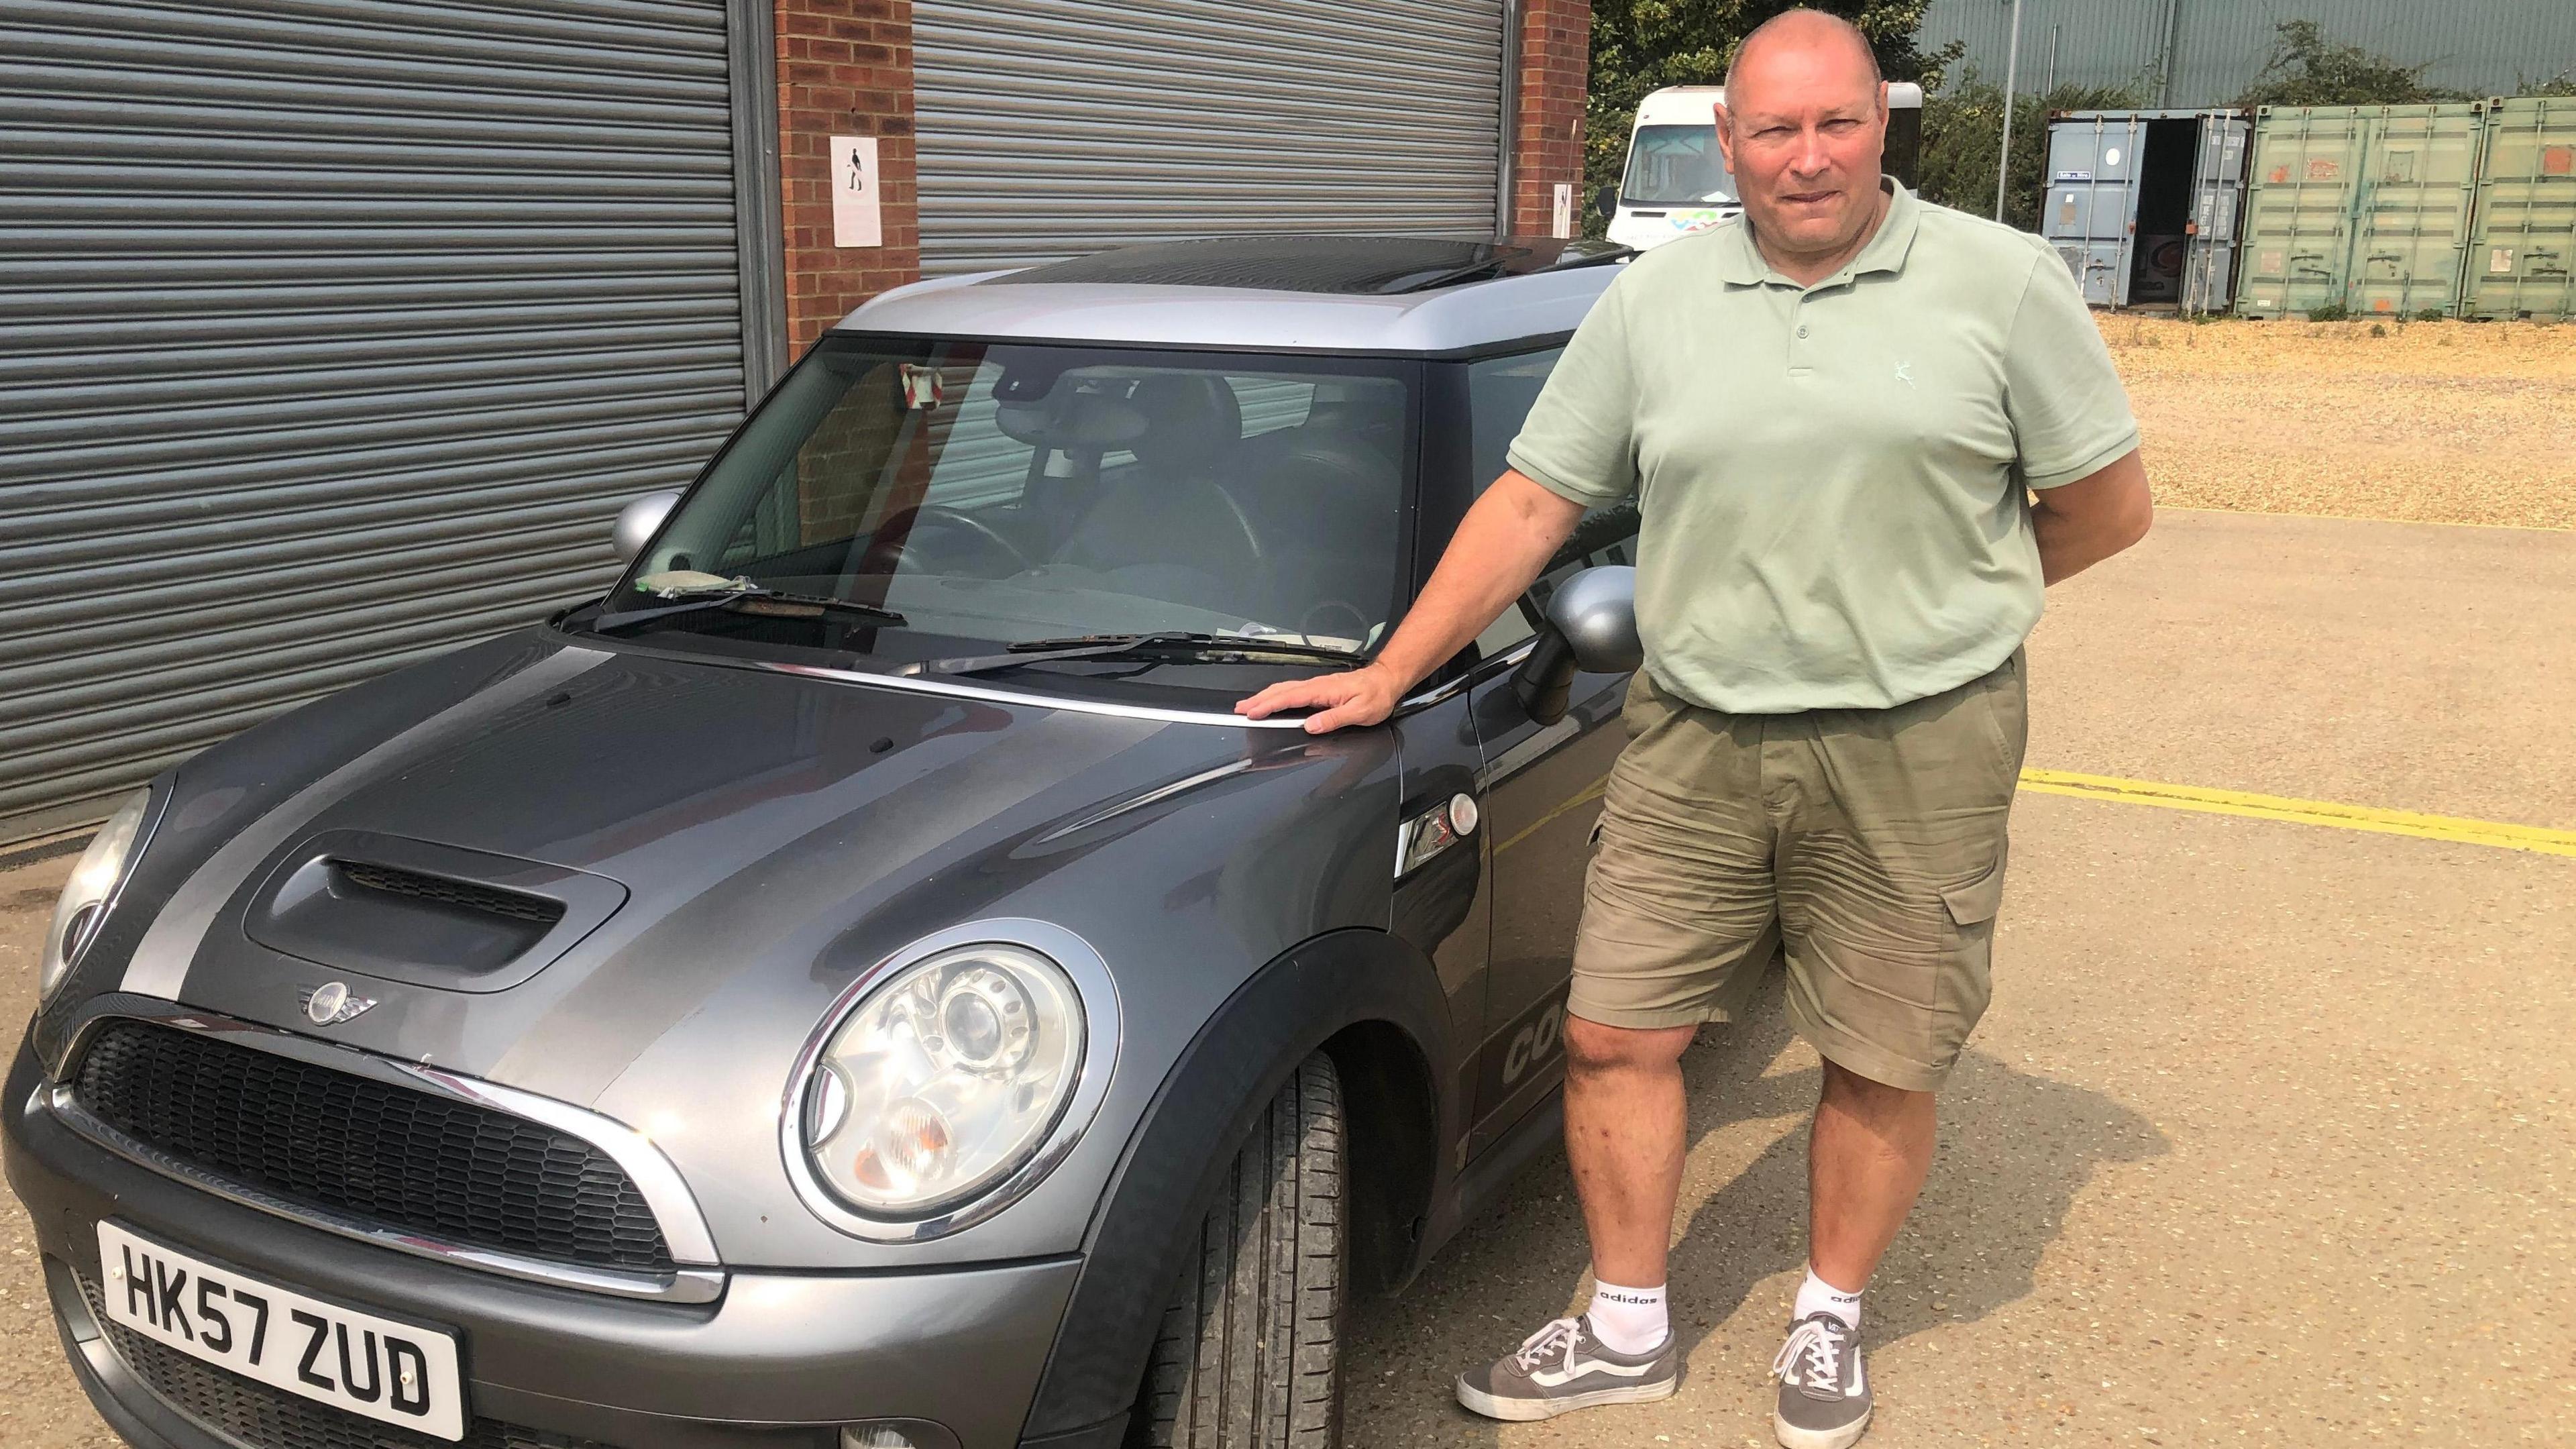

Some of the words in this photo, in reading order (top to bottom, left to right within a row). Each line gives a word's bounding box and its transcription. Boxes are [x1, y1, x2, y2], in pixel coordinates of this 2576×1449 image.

[1503, 1002, 1566, 1085] CO
[122, 1244, 269, 1366] HK57
[290, 1308, 431, 1416] ZUD
[1600, 1291, 1658, 1304] adidas
